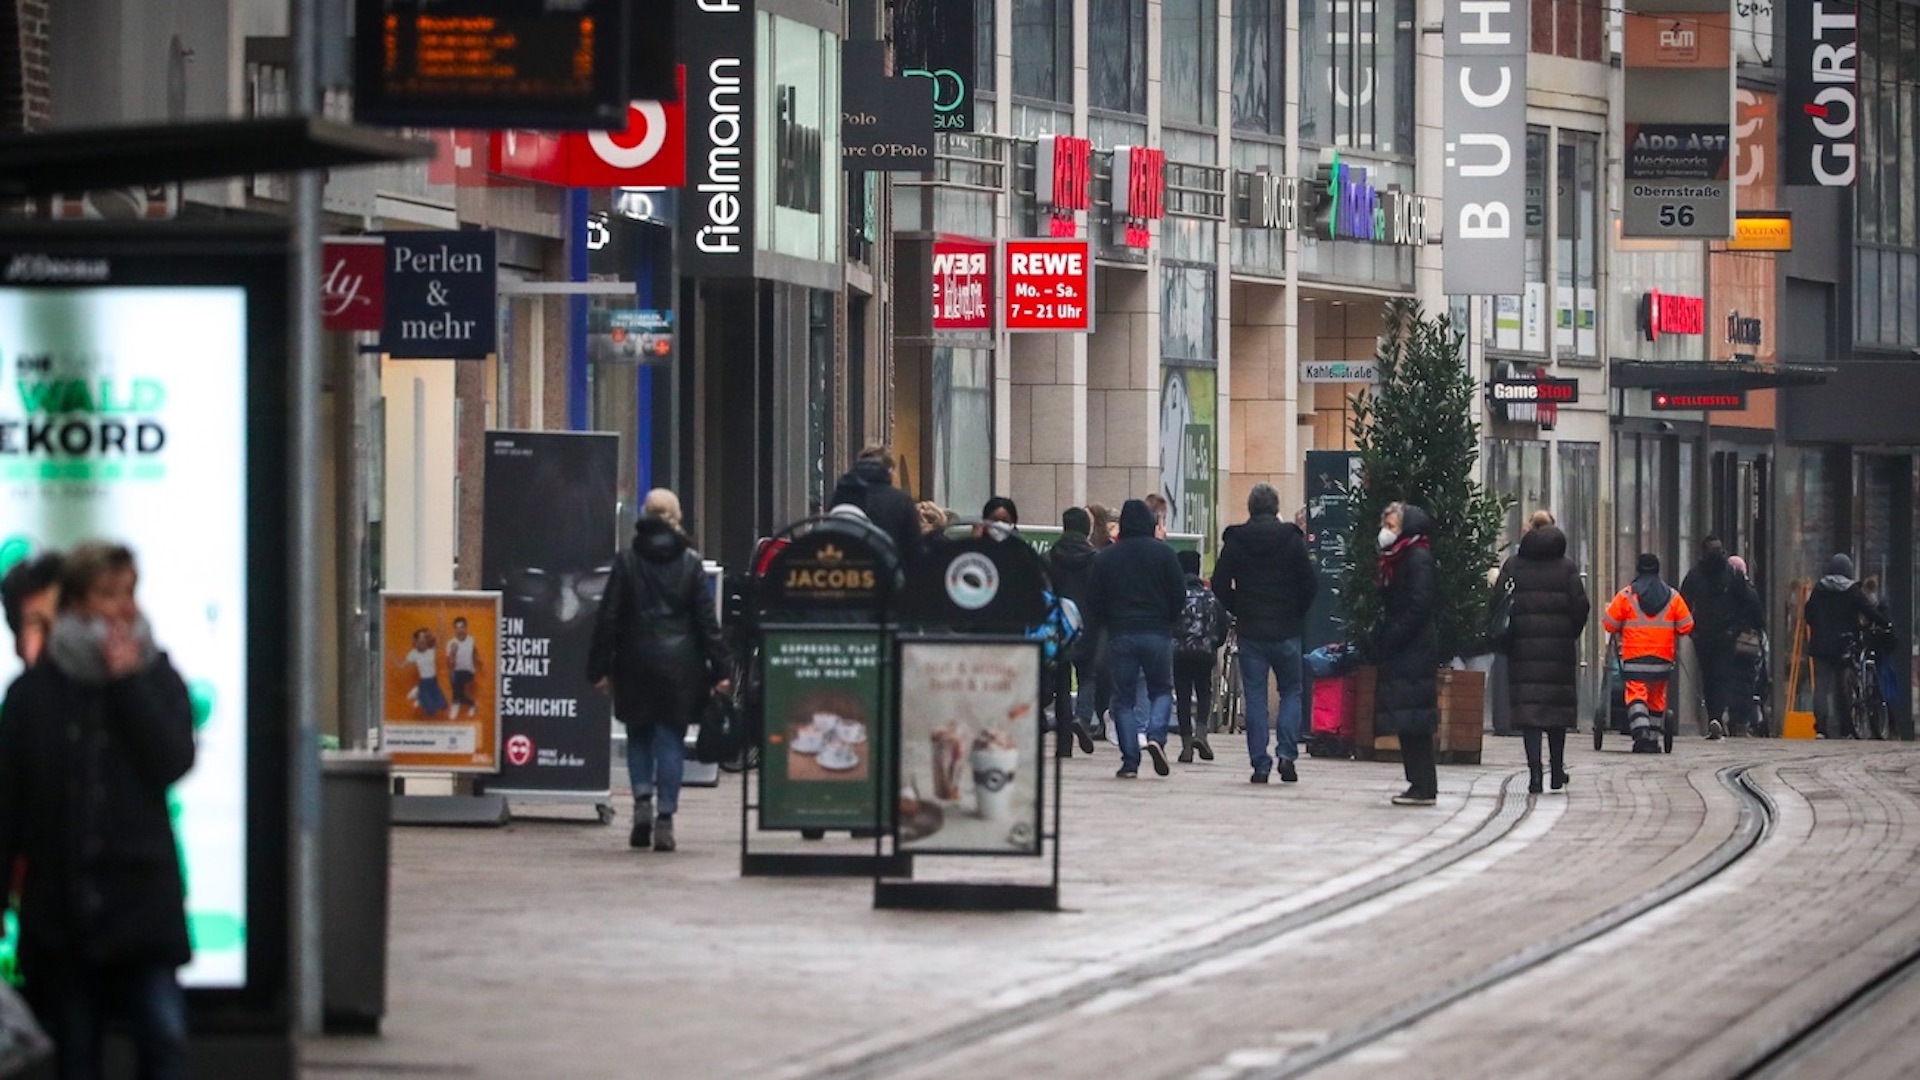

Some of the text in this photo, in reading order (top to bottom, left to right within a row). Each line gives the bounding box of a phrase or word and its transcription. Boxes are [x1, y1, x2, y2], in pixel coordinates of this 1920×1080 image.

[1446, 1, 1511, 239] BÜCH
[696, 58, 740, 253] fielmann
[871, 143, 928, 157] O'Polo
[1633, 185, 1721, 198] Obernstraße
[1659, 205, 1696, 228] 56
[394, 244, 484, 273] Perlen
[1011, 253, 1083, 275] REWE
[426, 279, 449, 307] &
[1015, 283, 1041, 298] Mo.
[1056, 283, 1078, 298] Sa.
[1011, 303, 1021, 319] 7
[1036, 303, 1054, 319] 21
[1057, 303, 1083, 319] Uhr
[401, 311, 476, 340] mehr
[17, 380, 165, 414] WALD
[785, 570, 875, 588] JACOBS
